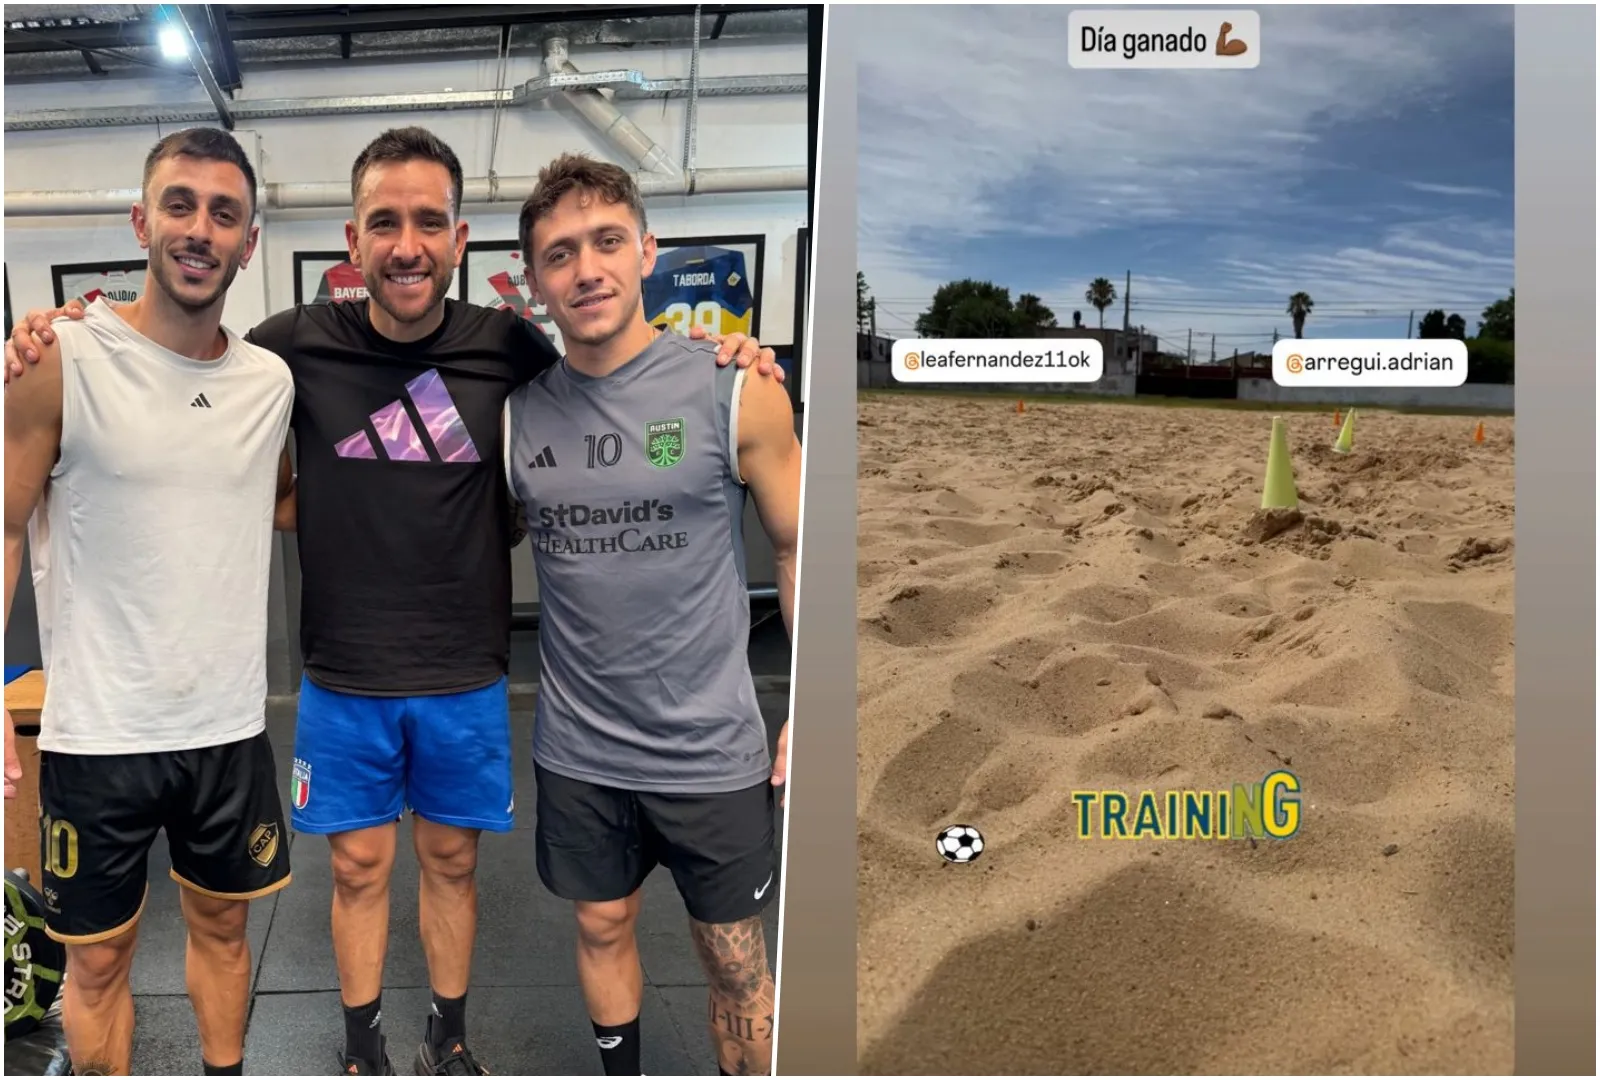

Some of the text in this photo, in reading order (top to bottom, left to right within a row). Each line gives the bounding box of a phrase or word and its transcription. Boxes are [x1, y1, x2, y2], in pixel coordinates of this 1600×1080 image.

[672, 271, 716, 287] TABORDA
[105, 289, 138, 302] OLIDIO
[650, 422, 680, 432] AUSTIN
[584, 432, 623, 469] 10
[43, 814, 79, 879] 10
[252, 830, 272, 853] CAP
